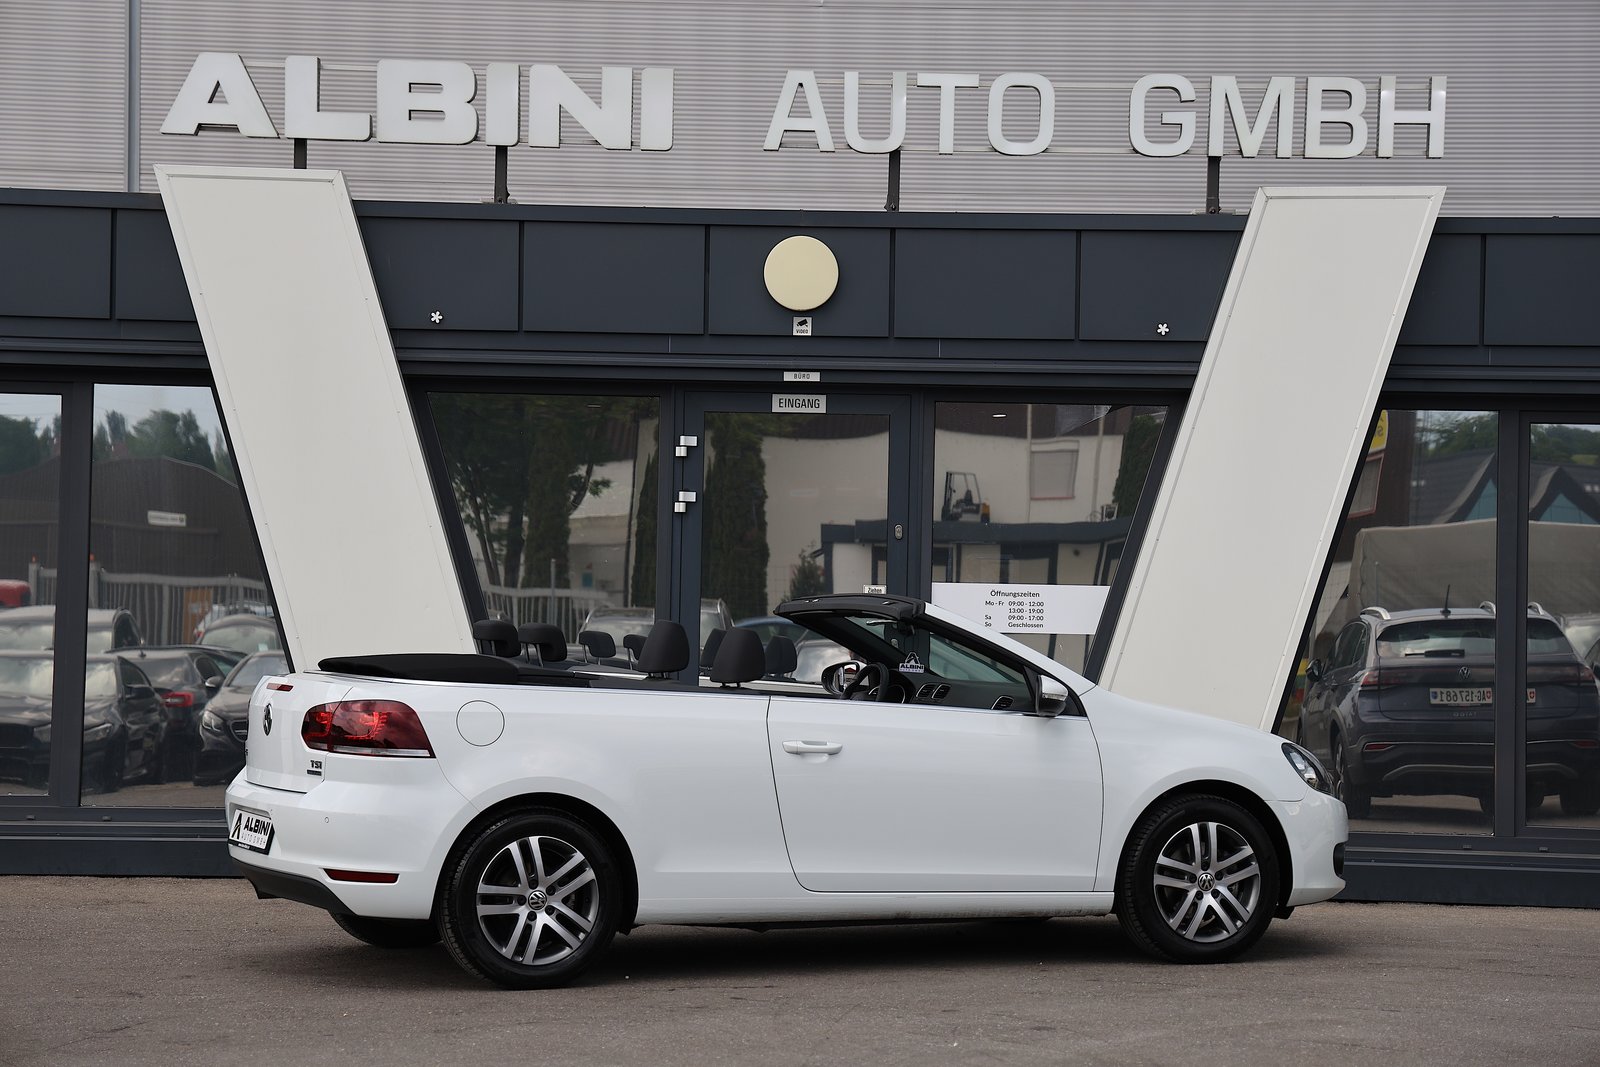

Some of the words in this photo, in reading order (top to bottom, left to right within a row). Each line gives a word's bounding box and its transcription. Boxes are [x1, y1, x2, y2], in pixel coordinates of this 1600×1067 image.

[159, 51, 675, 152] ALBINI
[763, 69, 1056, 155] AUTO
[1128, 73, 1448, 159] GMBH
[778, 398, 820, 409] EINGANG
[990, 589, 1040, 598] Öffnungszeiten
[310, 760, 322, 769] TSI
[243, 816, 270, 836] ALBINI
